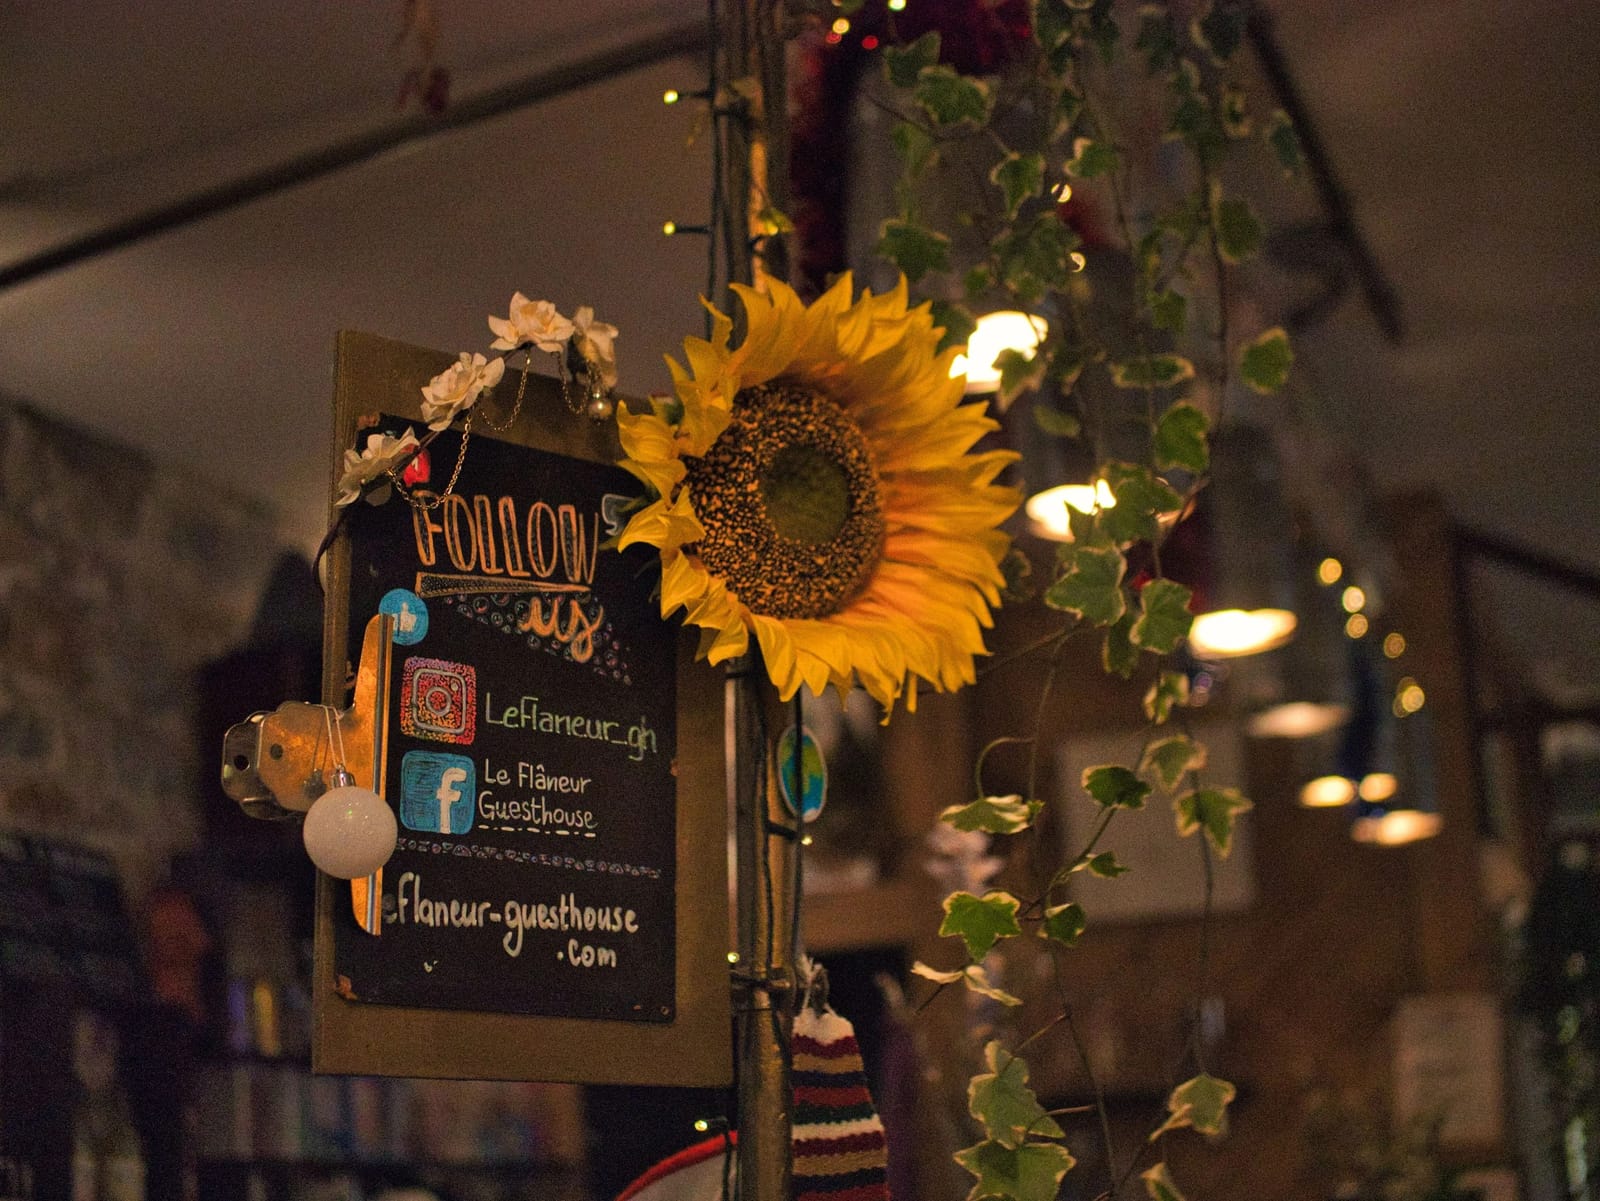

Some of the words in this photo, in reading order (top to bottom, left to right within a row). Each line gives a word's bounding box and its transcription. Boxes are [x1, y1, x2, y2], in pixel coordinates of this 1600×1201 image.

[411, 489, 599, 585] FOLLOW
[517, 596, 604, 664] us
[485, 691, 657, 762] LeFlaneur_gh
[478, 790, 599, 829] Guesthouse
[484, 758, 511, 785] Le
[518, 761, 592, 793] Flâneur
